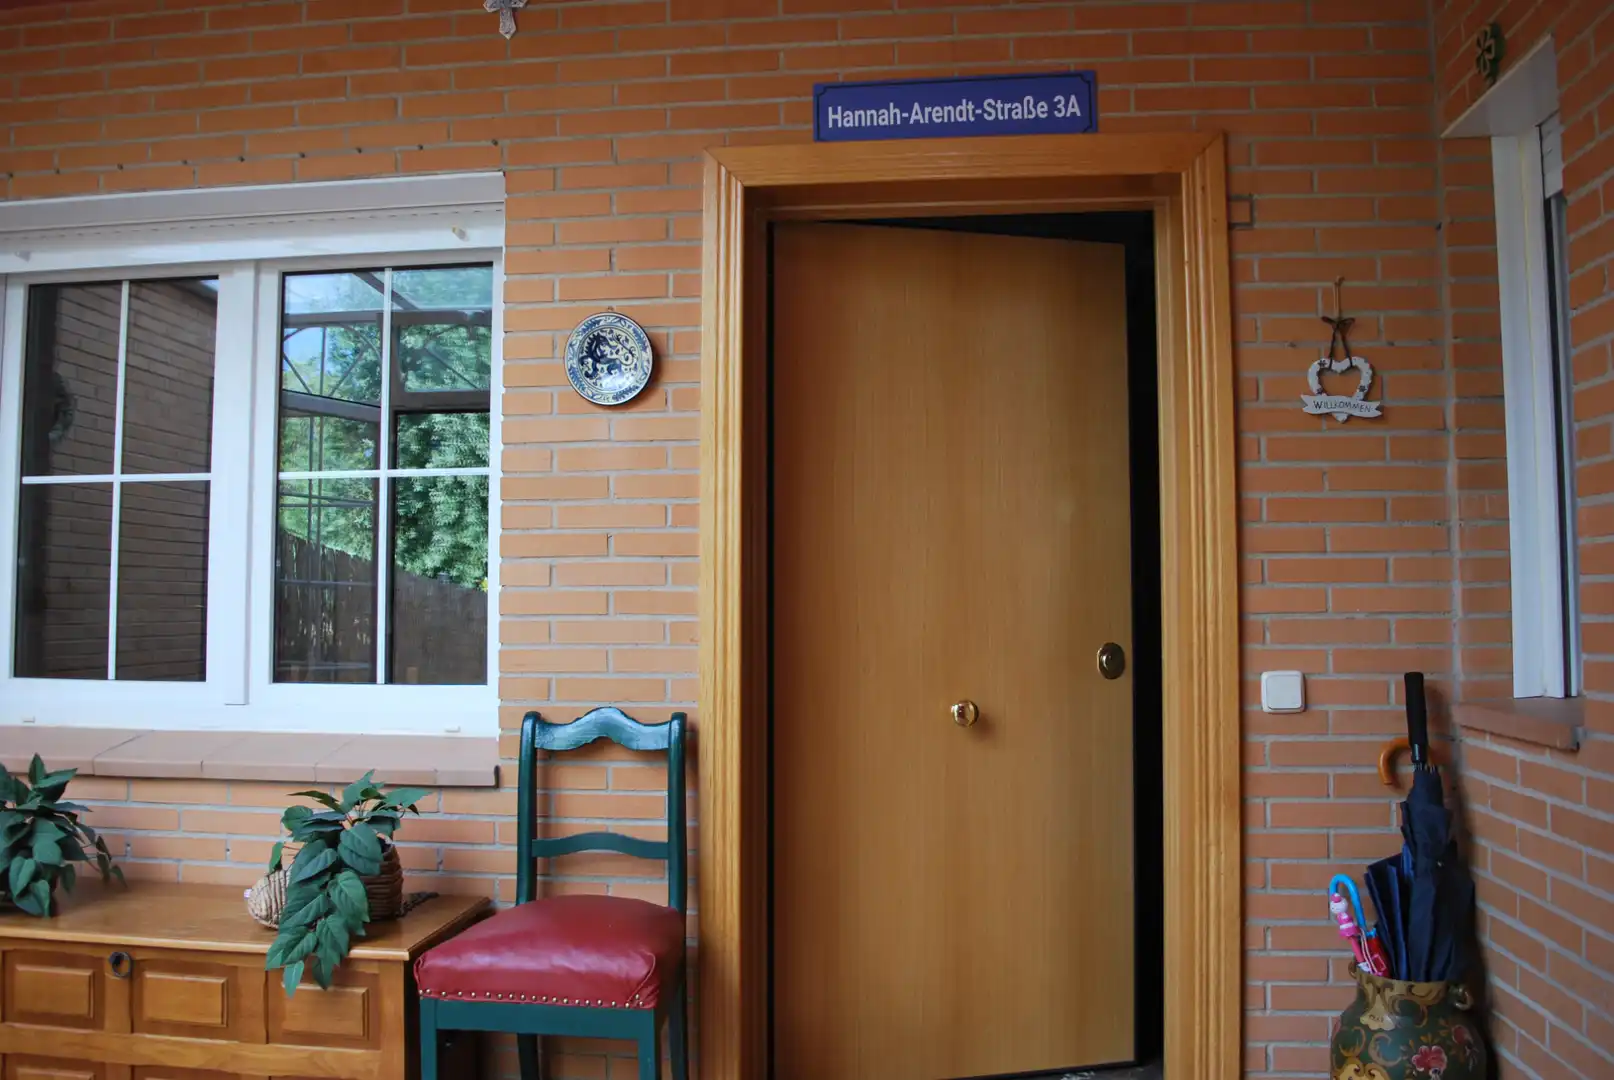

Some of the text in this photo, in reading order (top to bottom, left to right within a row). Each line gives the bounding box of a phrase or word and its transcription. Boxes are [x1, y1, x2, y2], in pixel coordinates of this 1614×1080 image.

[828, 95, 1081, 128] Hannah-Arendt-Straße 3A
[1313, 401, 1371, 412] WILLKOMMEN
